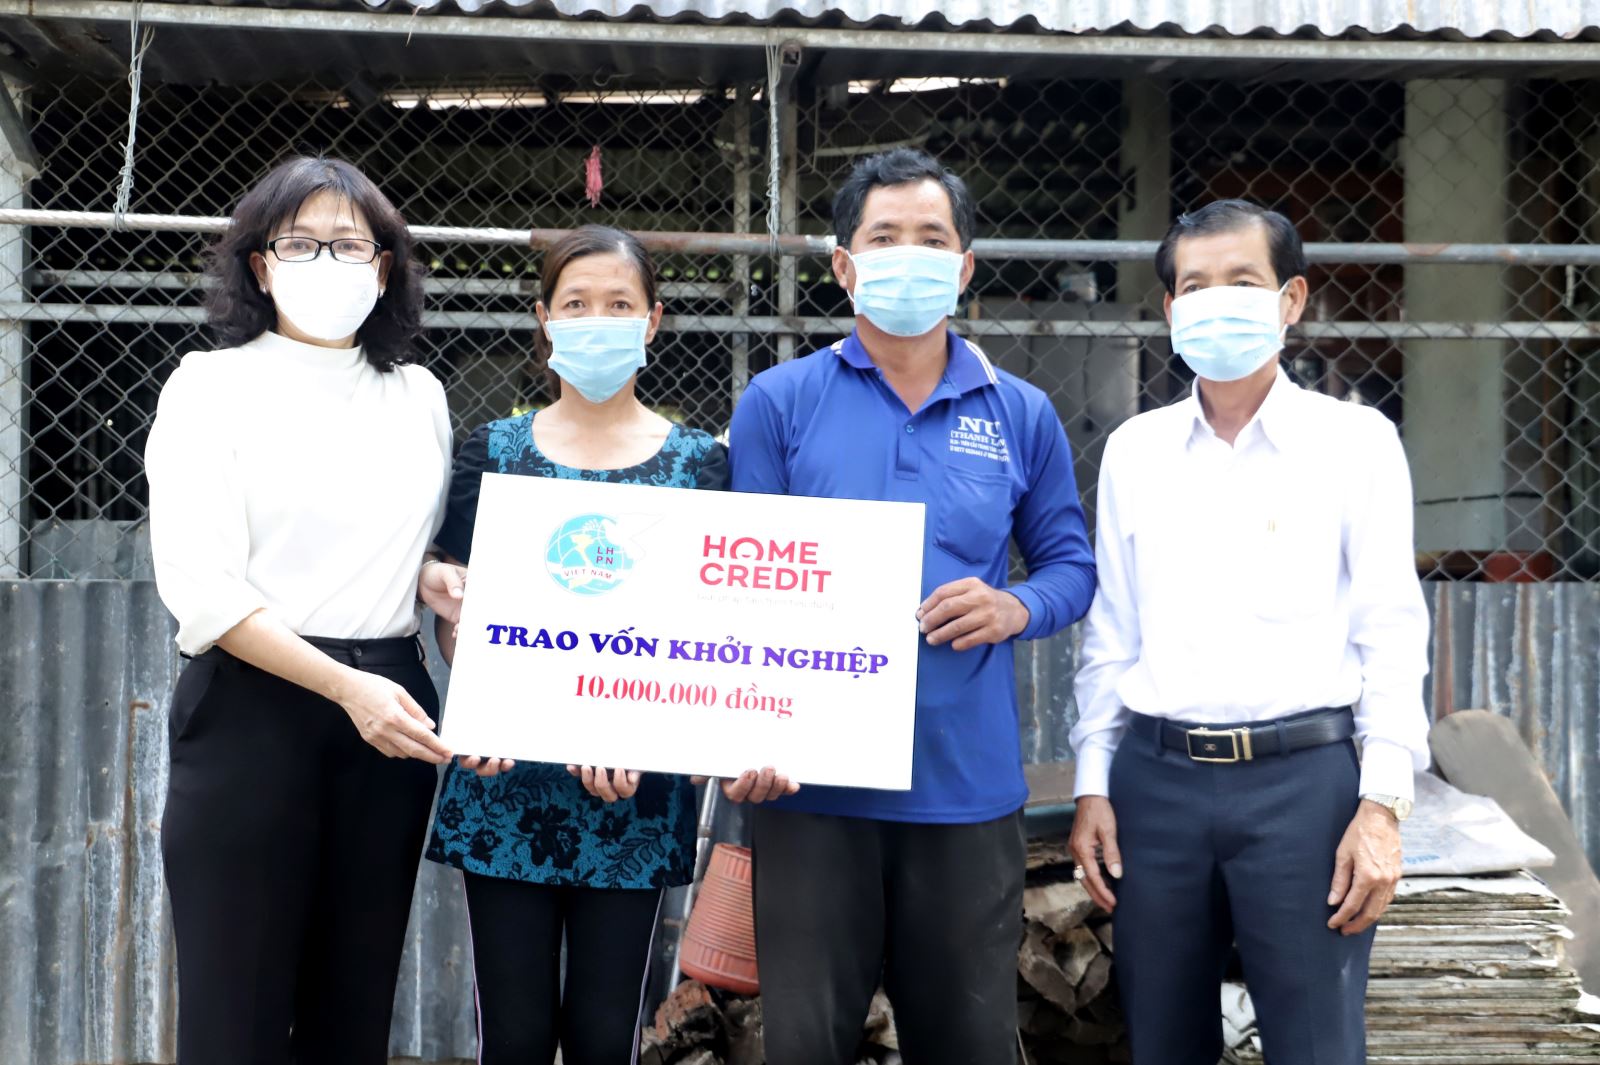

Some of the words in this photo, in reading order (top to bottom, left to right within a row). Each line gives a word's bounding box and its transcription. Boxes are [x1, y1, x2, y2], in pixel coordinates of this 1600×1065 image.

[703, 535, 819, 565] HOME
[700, 562, 832, 593] CREDIT
[486, 624, 579, 651] TRAO
[589, 626, 659, 658] VỐN
[667, 635, 753, 665] KHỞI
[762, 646, 889, 679] NGHIỆP
[574, 674, 717, 707] 10.000.000
[725, 682, 793, 719] đồng
